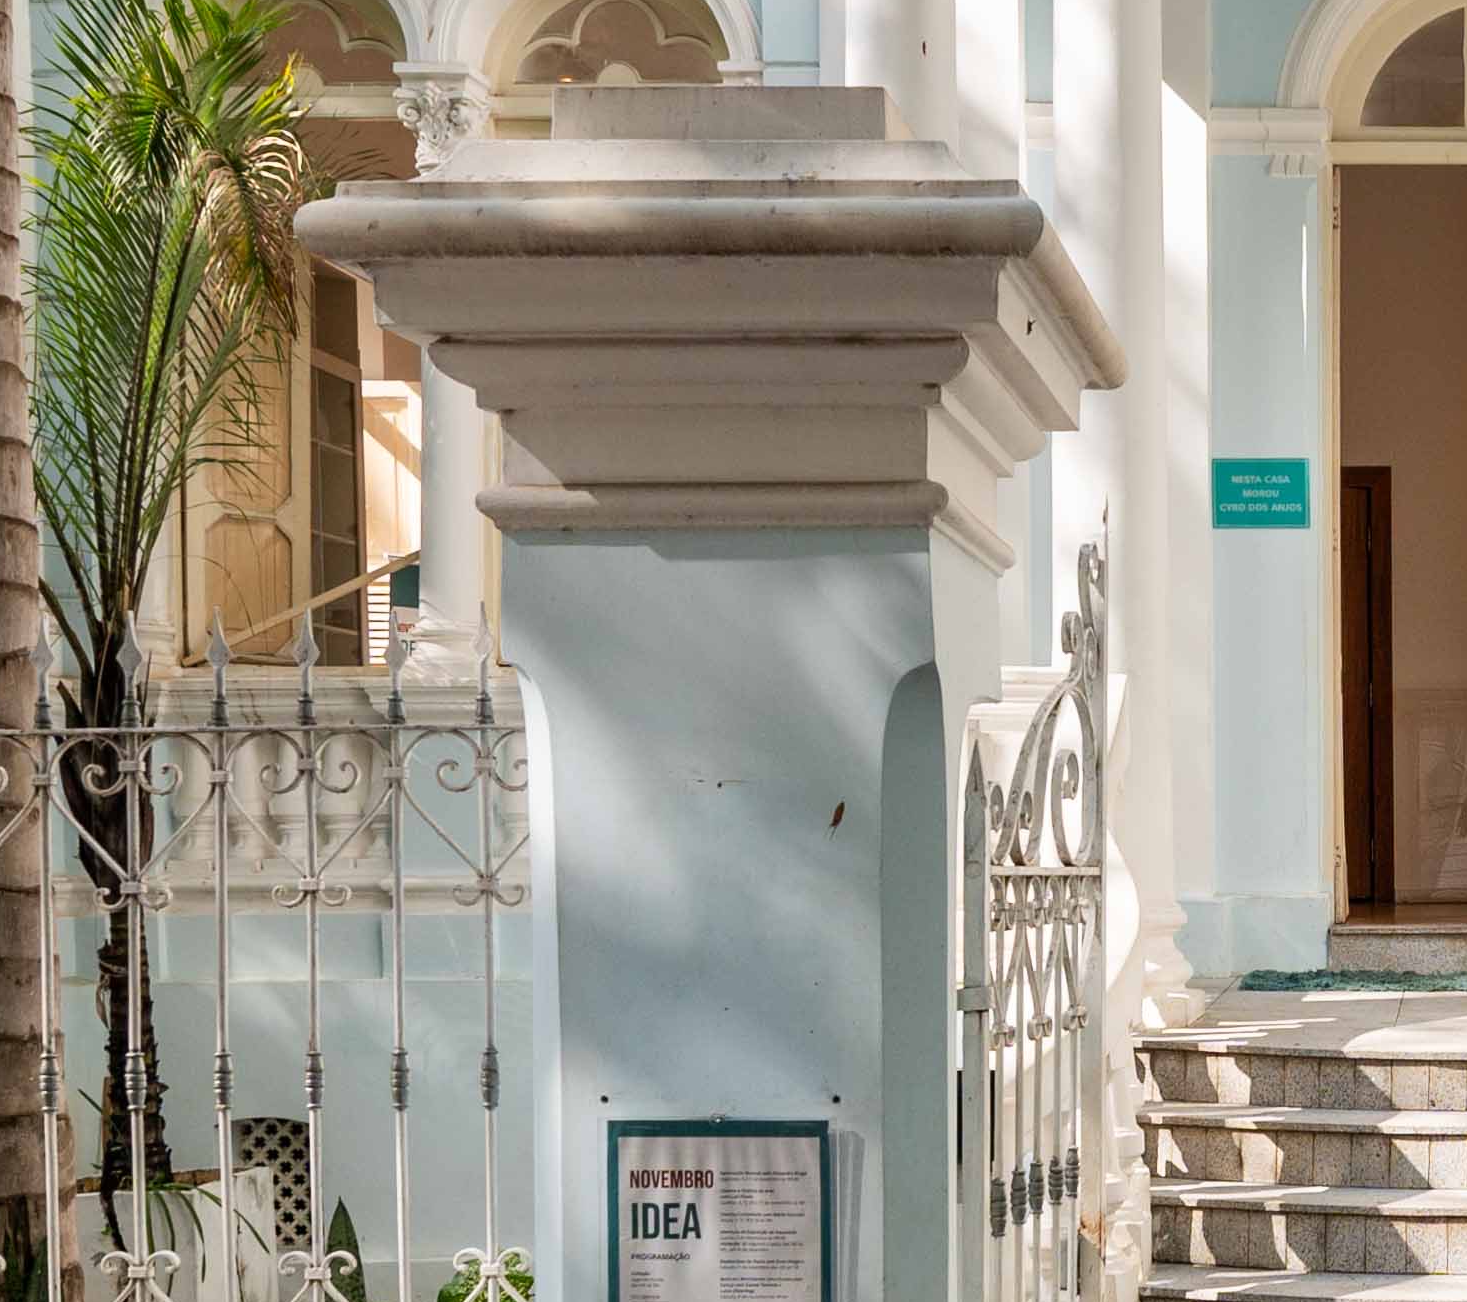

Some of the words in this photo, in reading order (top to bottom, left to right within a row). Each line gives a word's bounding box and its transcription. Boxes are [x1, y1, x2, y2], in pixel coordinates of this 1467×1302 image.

[1231, 475, 1262, 484] NESTA
[1264, 475, 1291, 484] CASA
[1242, 489, 1279, 498] MOROU
[1248, 503, 1268, 512] DOS
[1271, 503, 1302, 512] ANJOS
[629, 1169, 714, 1189] NOVEMBRO
[632, 1202, 702, 1240] IDEA
